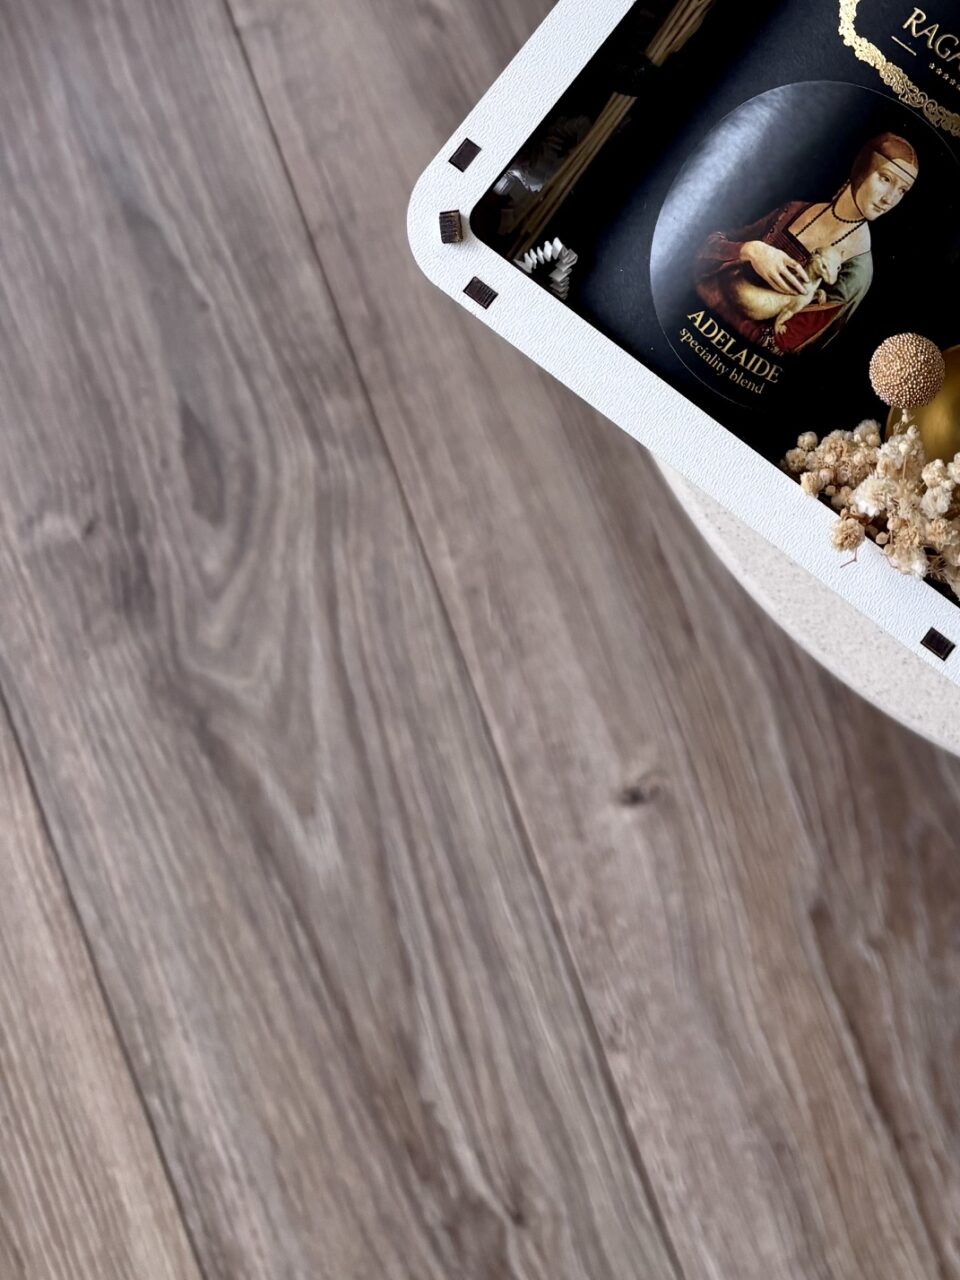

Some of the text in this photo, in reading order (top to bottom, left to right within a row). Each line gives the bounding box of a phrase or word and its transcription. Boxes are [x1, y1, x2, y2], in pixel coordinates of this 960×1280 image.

[679, 327, 766, 395] speciality blend
[687, 310, 784, 384] ADELAIDE
